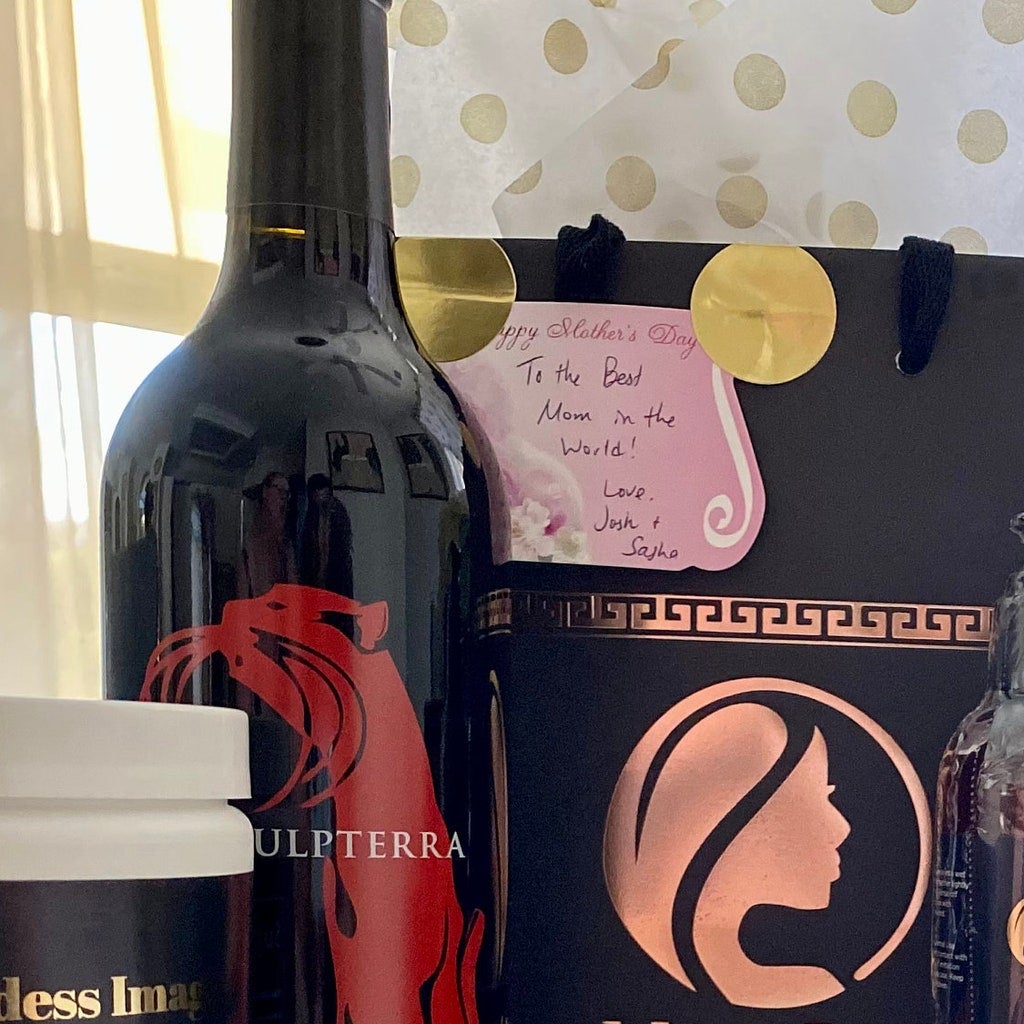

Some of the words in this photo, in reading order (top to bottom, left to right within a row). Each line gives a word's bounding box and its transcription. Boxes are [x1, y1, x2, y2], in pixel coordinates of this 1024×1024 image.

[496, 325, 539, 351] ppy
[546, 317, 637, 342] Mother's
[650, 323, 699, 359] Day
[516, 356, 543, 386] To
[555, 359, 581, 387] the
[602, 356, 643, 388] Best
[537, 399, 592, 426] Mom
[614, 410, 635, 426] in
[644, 402, 676, 428] the
[561, 437, 637, 459] World!
[594, 506, 639, 532] Josh
[254, 828, 466, 858] ULPTERRA
